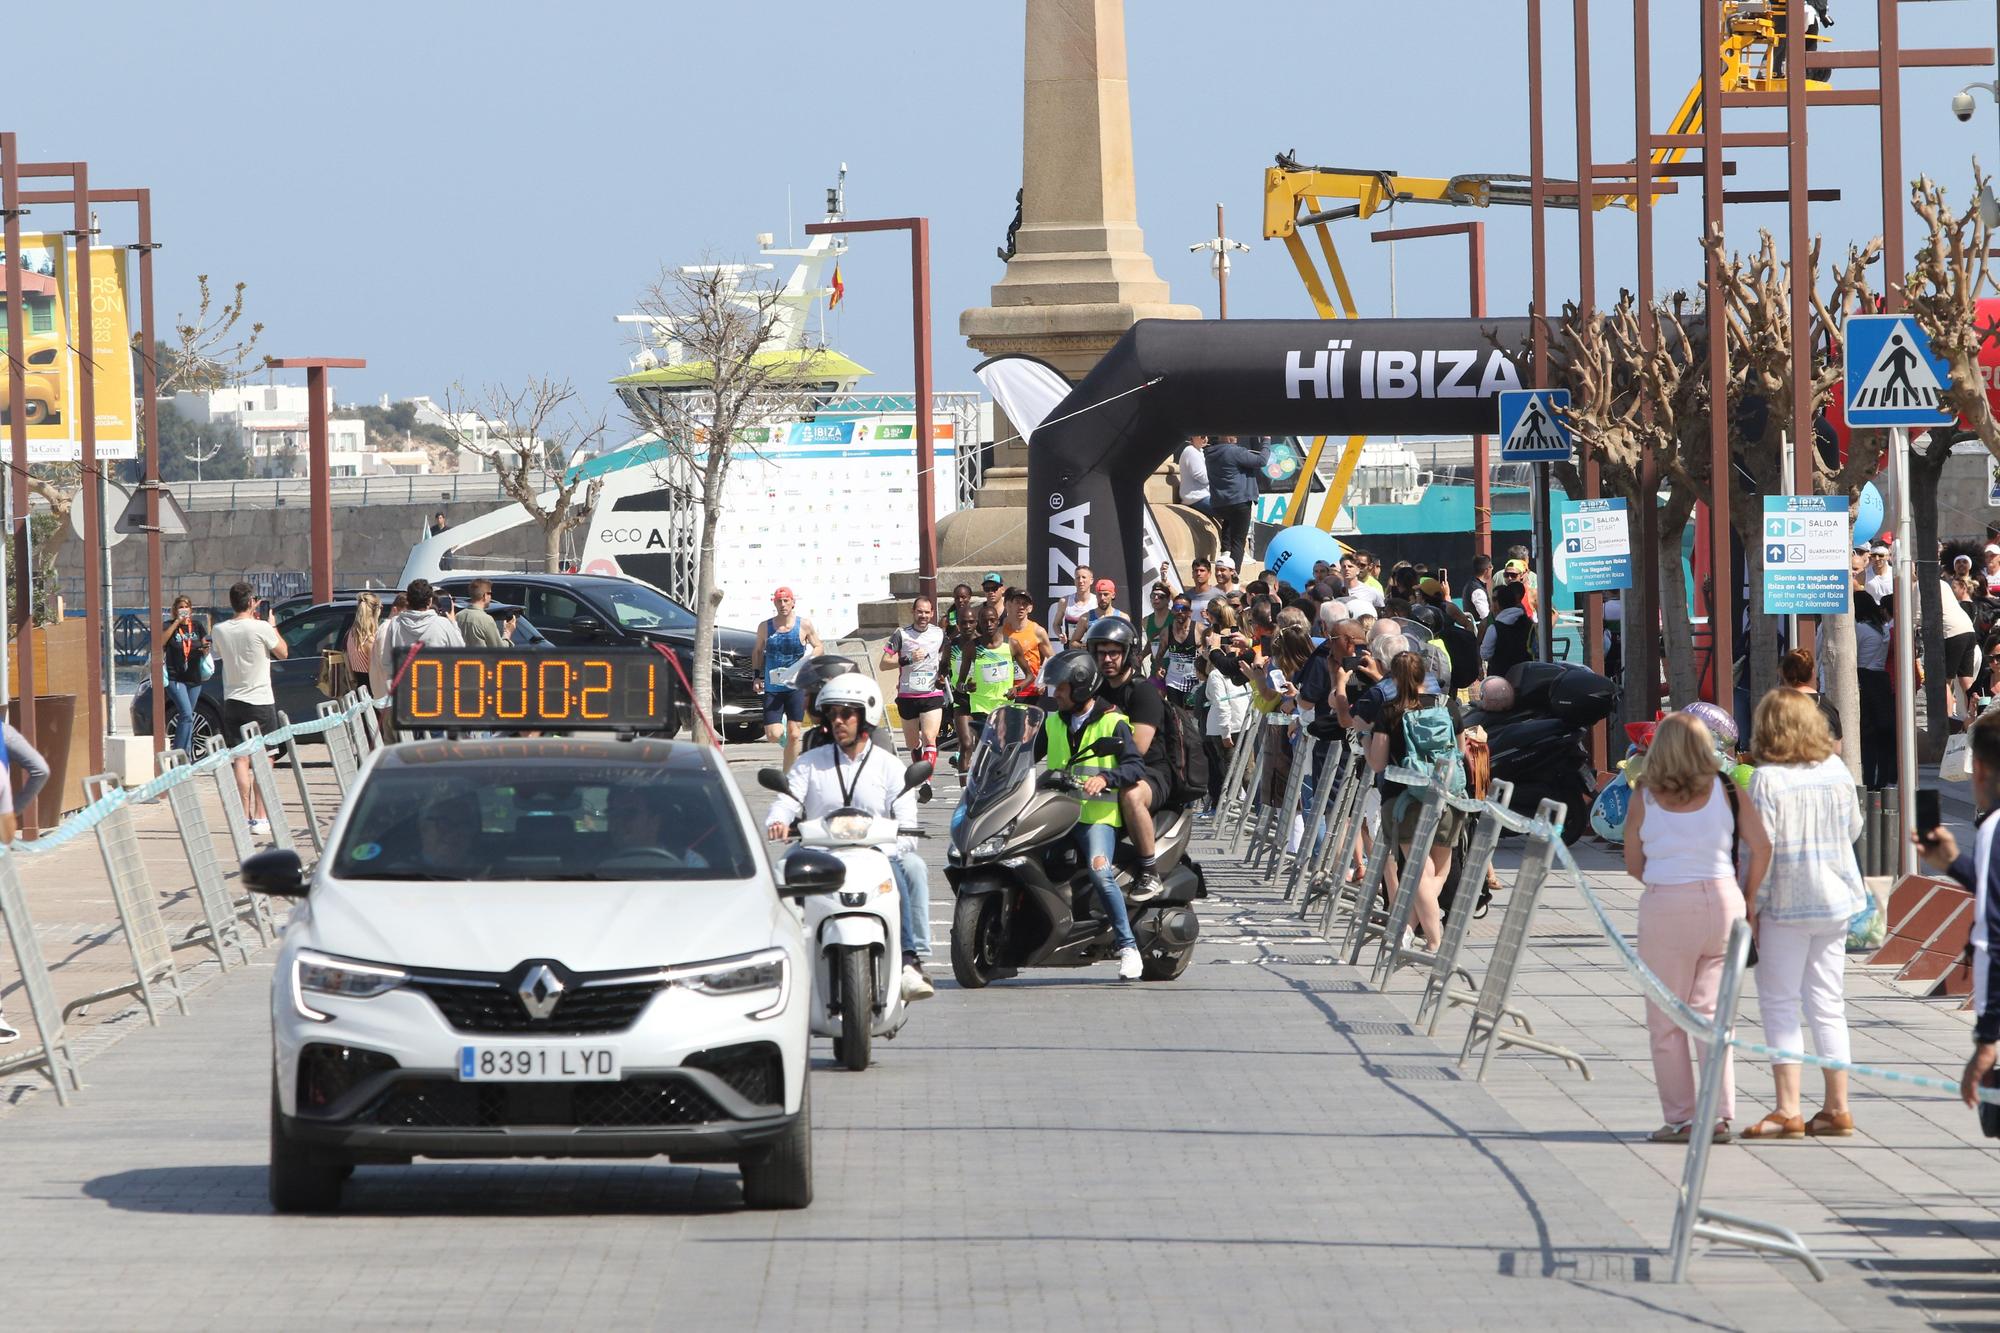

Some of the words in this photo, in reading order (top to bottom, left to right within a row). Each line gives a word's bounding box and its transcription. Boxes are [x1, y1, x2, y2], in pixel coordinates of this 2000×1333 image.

[1285, 339, 1353, 399] HÏ
[1360, 349, 1522, 399] IBIZA
[814, 427, 842, 437] IBIZA
[1808, 519, 1839, 527] SALIDA
[600, 528, 642, 543] eco
[1806, 574, 1828, 583] magia
[1796, 592, 1818, 600] magic
[1775, 600, 1794, 609] along
[991, 668, 997, 677] 2
[915, 677, 926, 685] 30
[411, 659, 655, 719] 00:00:21
[480, 1050, 547, 1075] 8391
[561, 1050, 613, 1075] LYD
